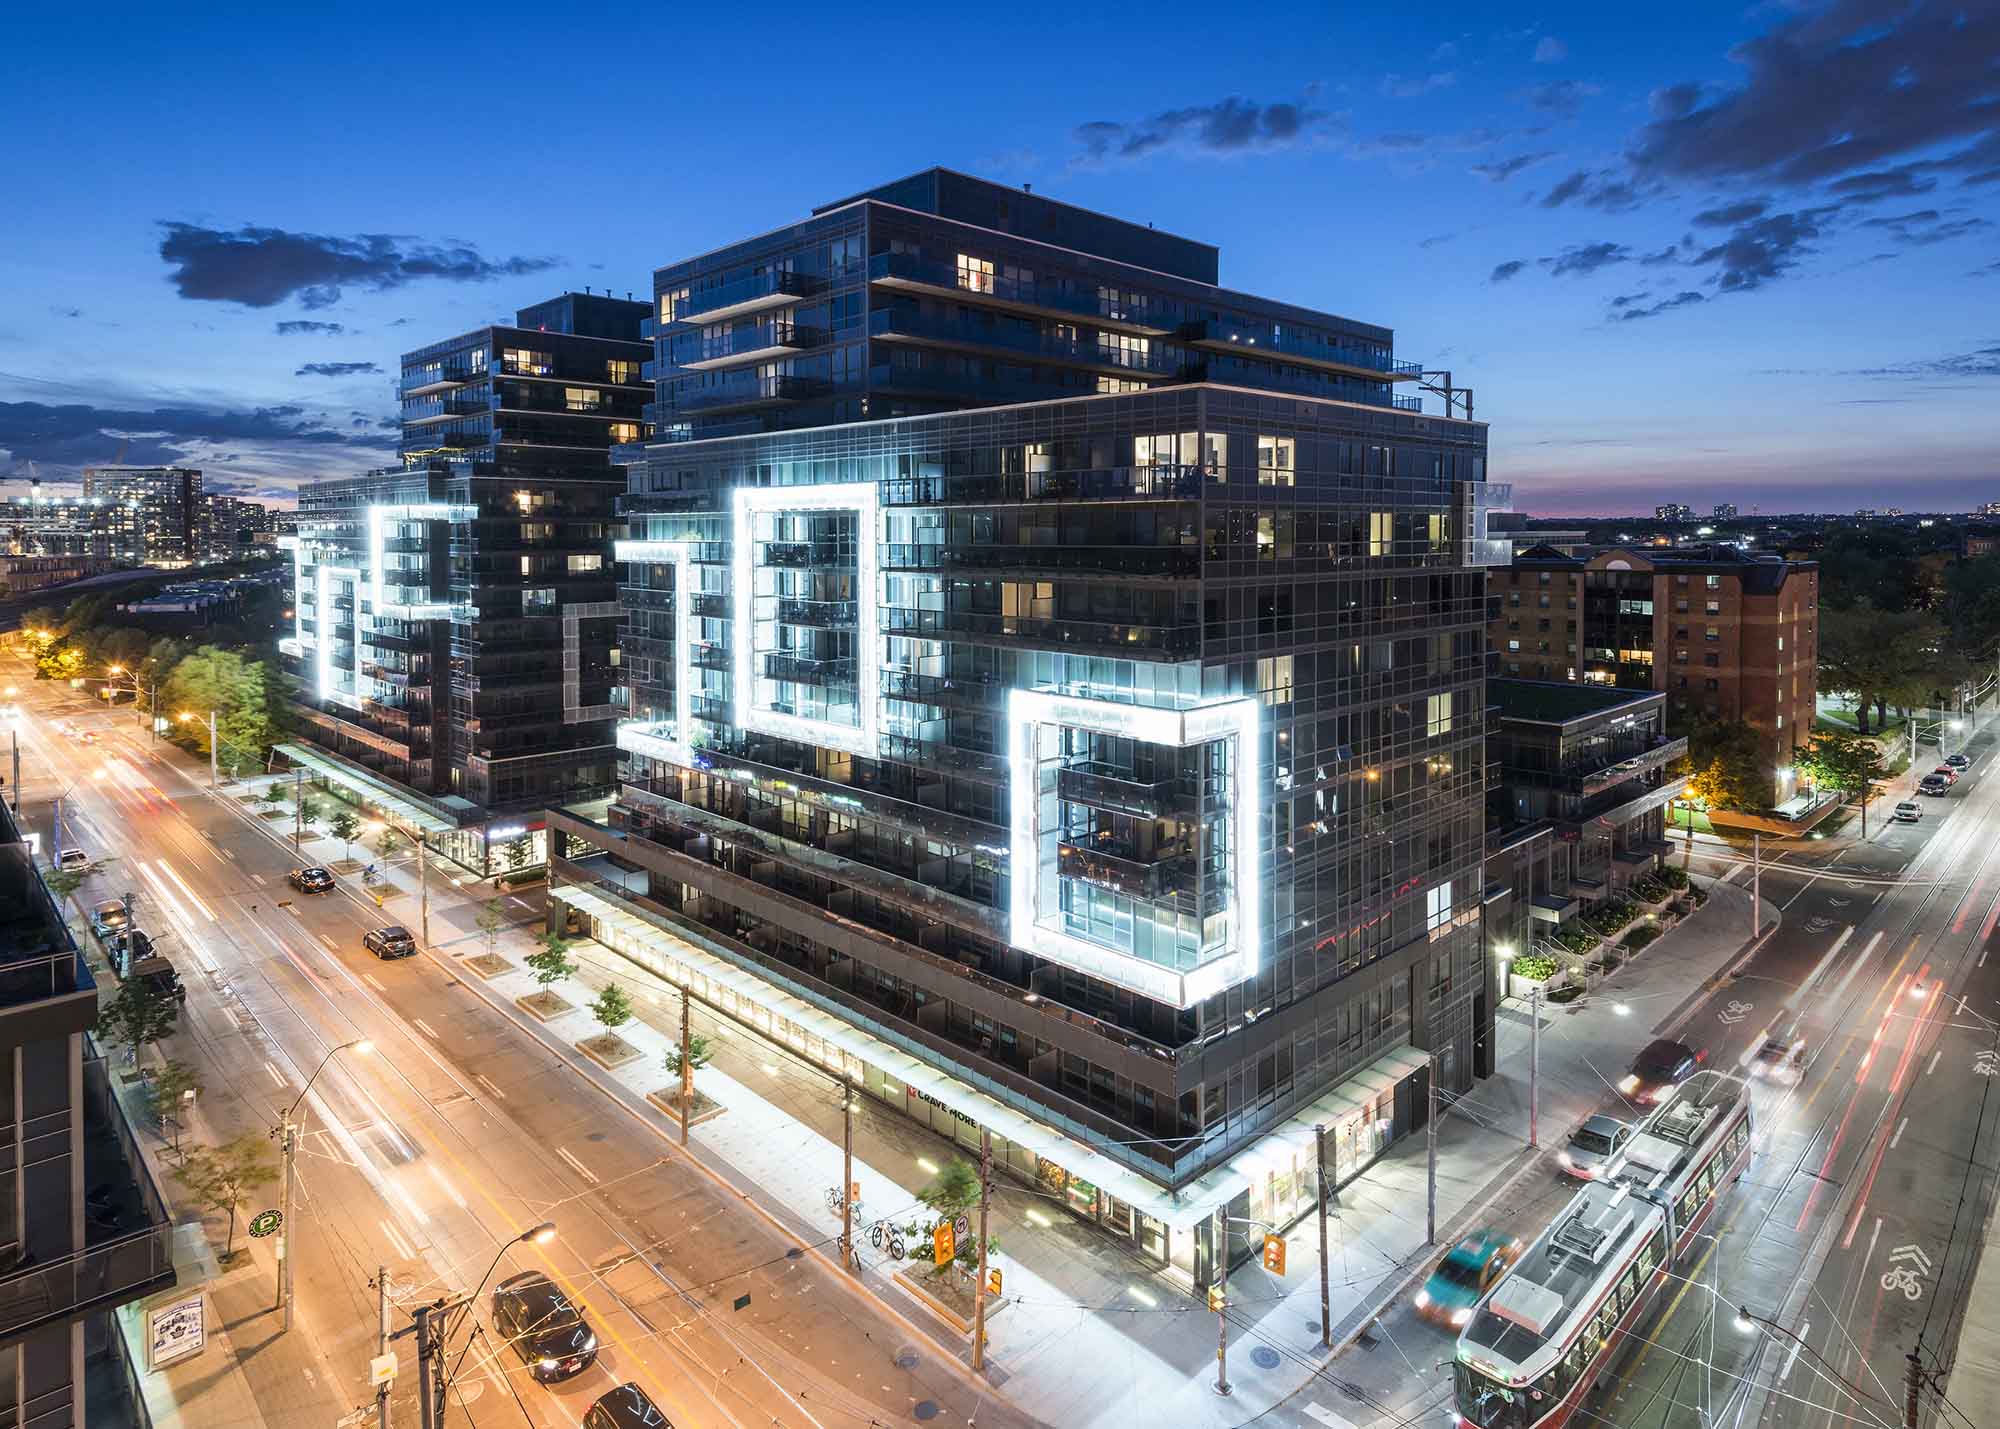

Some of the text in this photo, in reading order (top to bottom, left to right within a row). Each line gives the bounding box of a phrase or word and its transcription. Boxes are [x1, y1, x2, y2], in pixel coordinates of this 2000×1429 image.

[917, 1090, 976, 1128] CRAVE MORE
[260, 1215, 274, 1229] P
